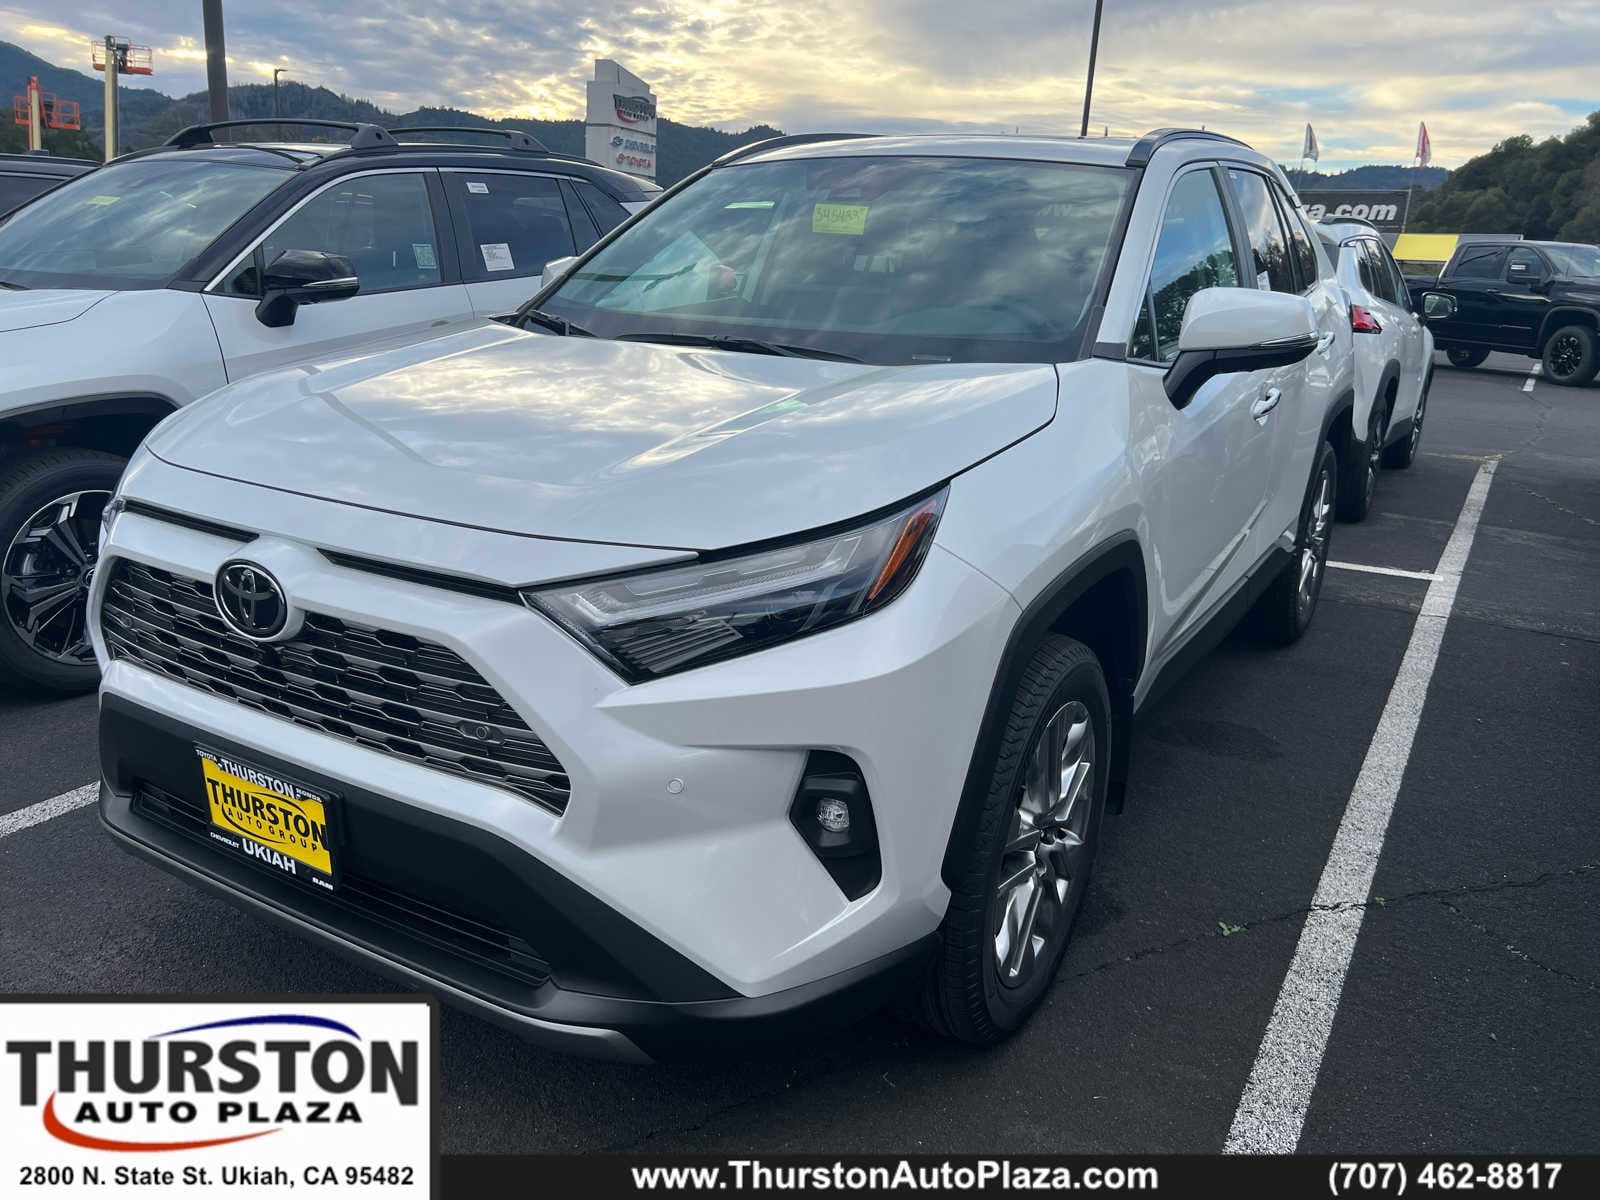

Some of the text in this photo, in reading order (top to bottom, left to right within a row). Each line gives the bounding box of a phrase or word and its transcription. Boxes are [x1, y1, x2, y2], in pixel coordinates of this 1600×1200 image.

[221, 759, 295, 799] THURSTON
[206, 777, 328, 850] THURSTON
[228, 808, 317, 851] AUTO GROUP
[242, 838, 297, 874] UKIAH
